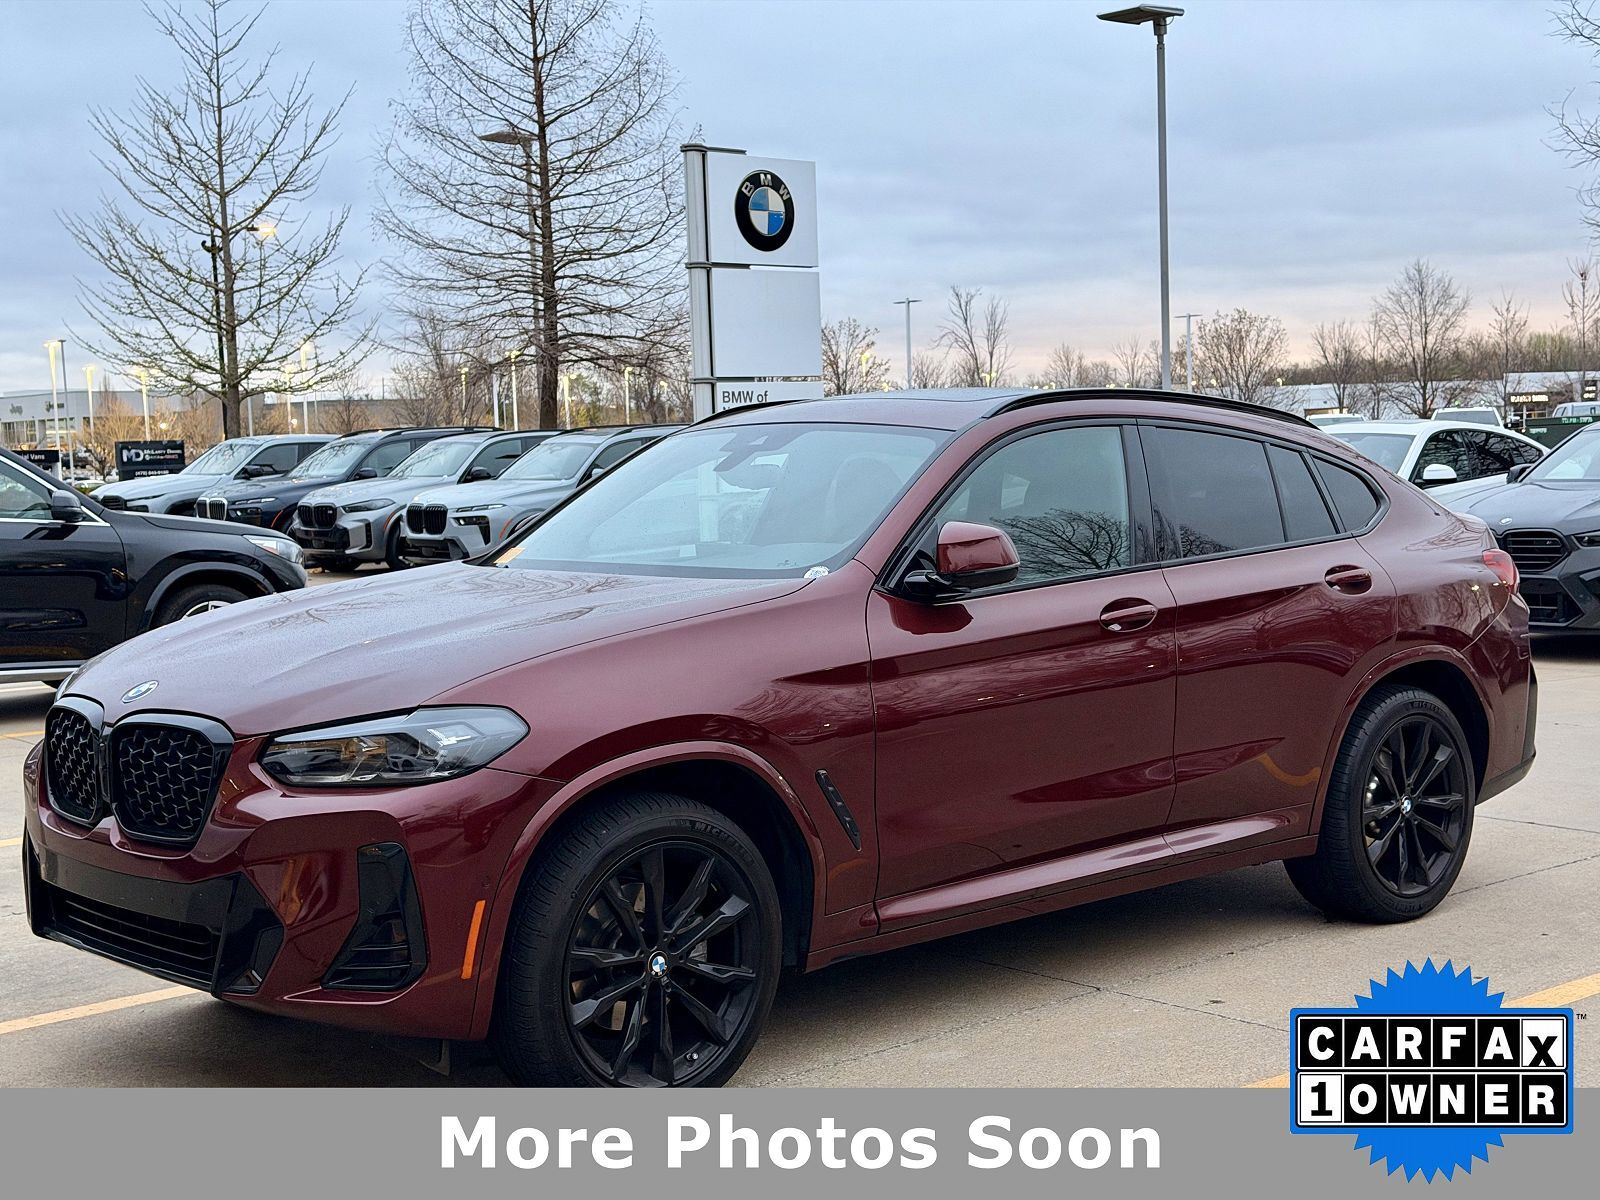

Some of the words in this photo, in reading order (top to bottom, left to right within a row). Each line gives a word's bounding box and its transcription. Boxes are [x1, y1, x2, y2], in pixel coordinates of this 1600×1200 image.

[741, 173, 791, 201] BMW
[722, 390, 754, 404] BMW
[756, 390, 769, 403] of
[122, 449, 144, 462] MD
